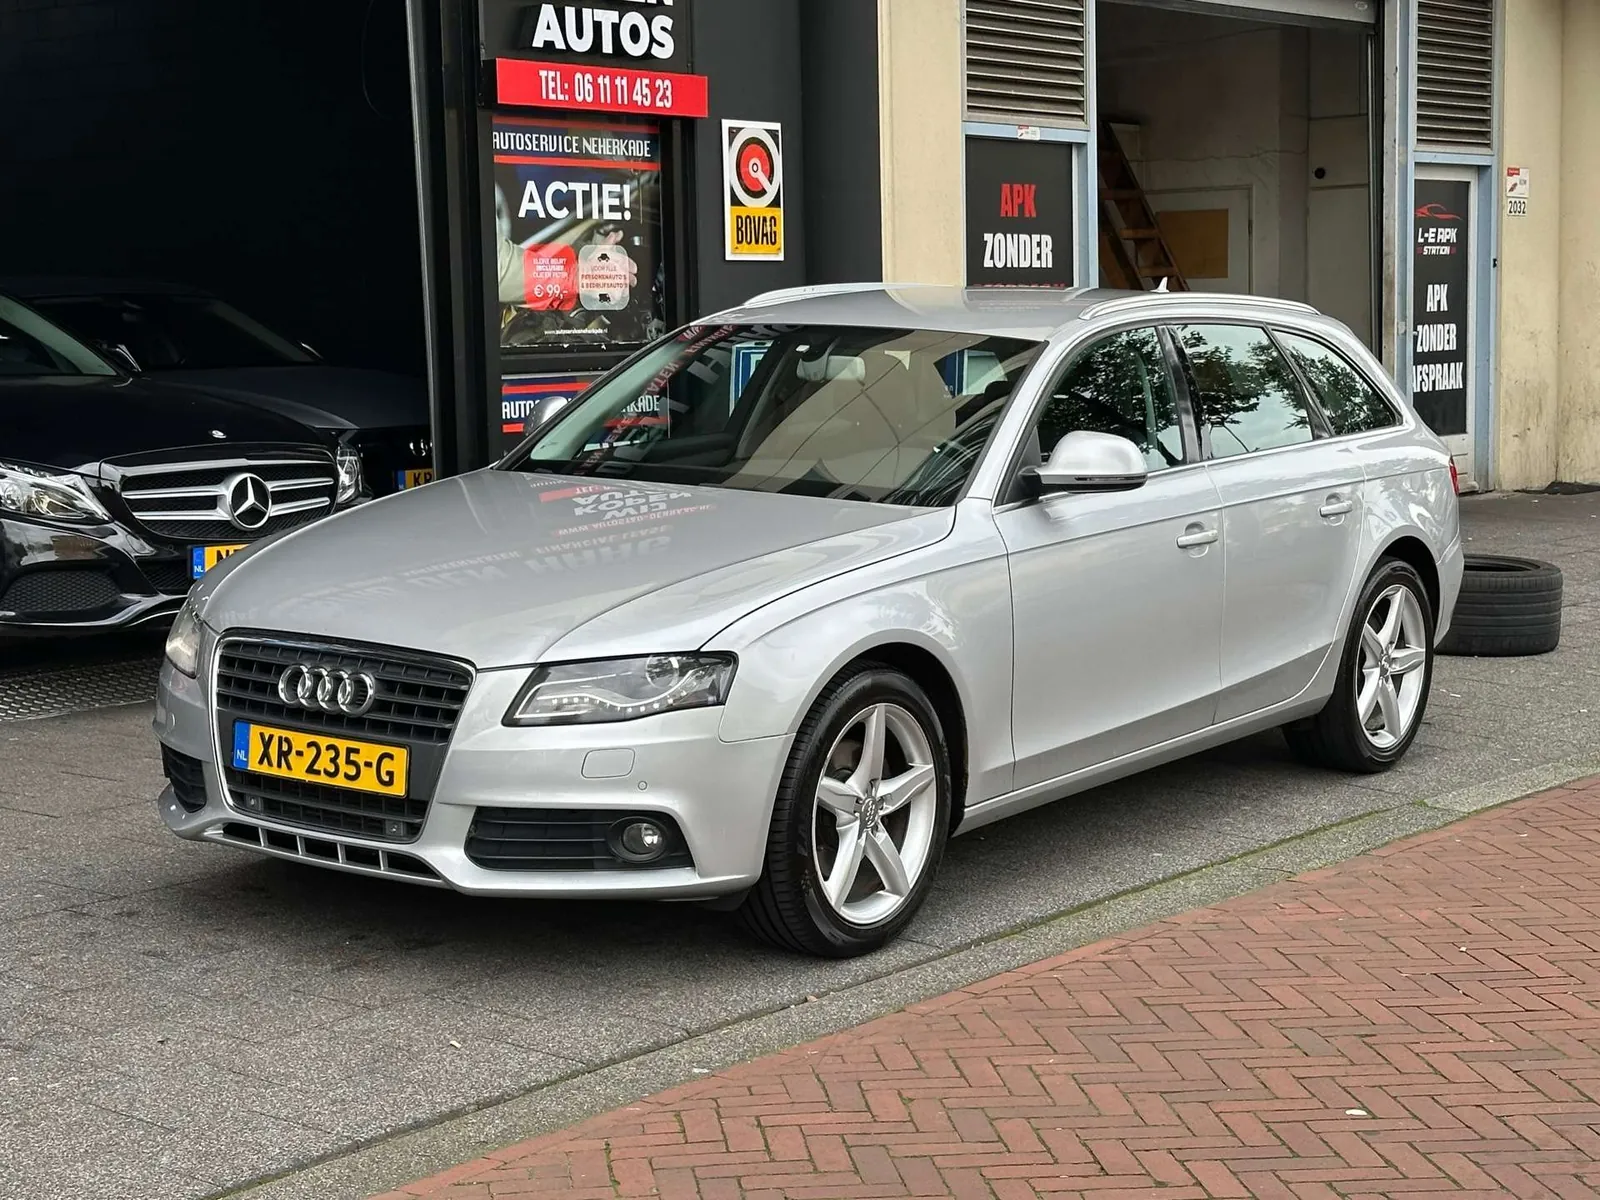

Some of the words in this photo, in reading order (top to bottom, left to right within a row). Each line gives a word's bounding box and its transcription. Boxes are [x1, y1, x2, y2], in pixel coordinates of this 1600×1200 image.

[532, 3, 675, 60] AUTOS
[538, 69, 569, 101] TEL:
[574, 72, 594, 103] 06
[597, 75, 611, 104] 11
[615, 76, 629, 105] 11
[632, 77, 652, 107] 45
[655, 78, 673, 109] 23
[492, 131, 580, 154] AUTOSERVICE
[582, 136, 652, 158] NEHERKADE
[518, 180, 632, 222] ACTIE!
[1000, 183, 1037, 218] APK
[1508, 200, 1527, 215] 2032
[735, 214, 778, 246] BOVAG
[983, 232, 1053, 269] ZONDER
[1422, 245, 1451, 255] STATION
[533, 284, 544, 298] €
[1426, 283, 1448, 312] APK
[1416, 323, 1457, 352] ZONDER
[193, 565, 204, 573] NL
[236, 749, 248, 761] NL
[257, 731, 396, 787] XR-235-G
